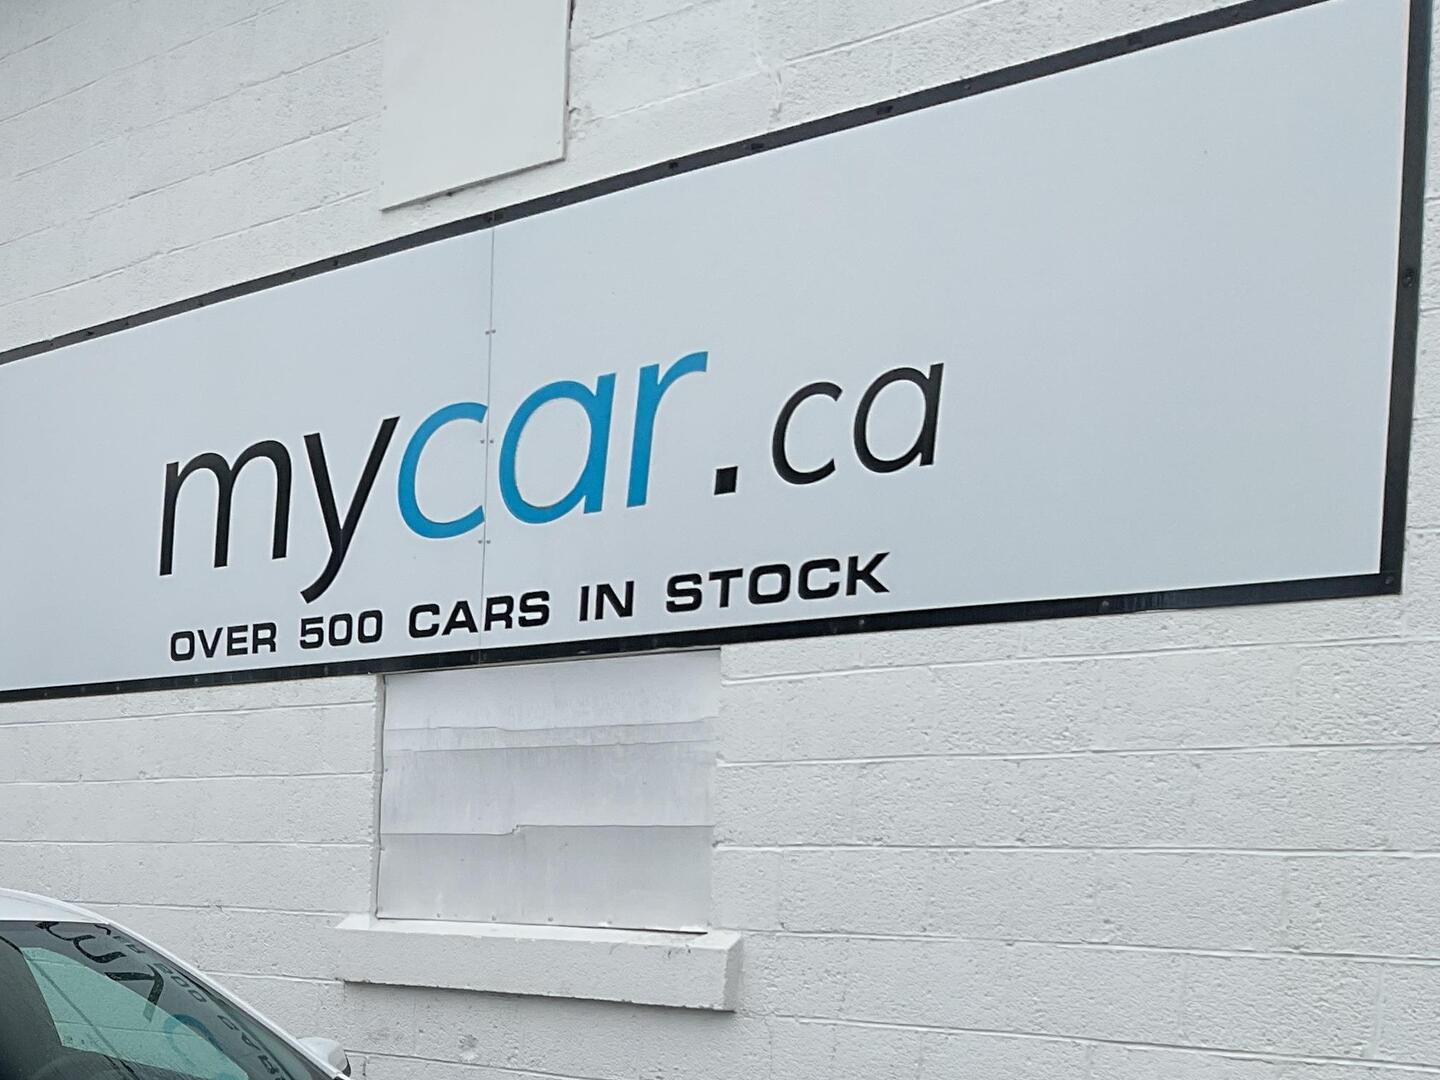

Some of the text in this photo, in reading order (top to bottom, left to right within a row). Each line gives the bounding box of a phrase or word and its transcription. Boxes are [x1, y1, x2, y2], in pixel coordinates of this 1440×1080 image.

[170, 552, 891, 662] OVER 500 CARS IN STOCK
